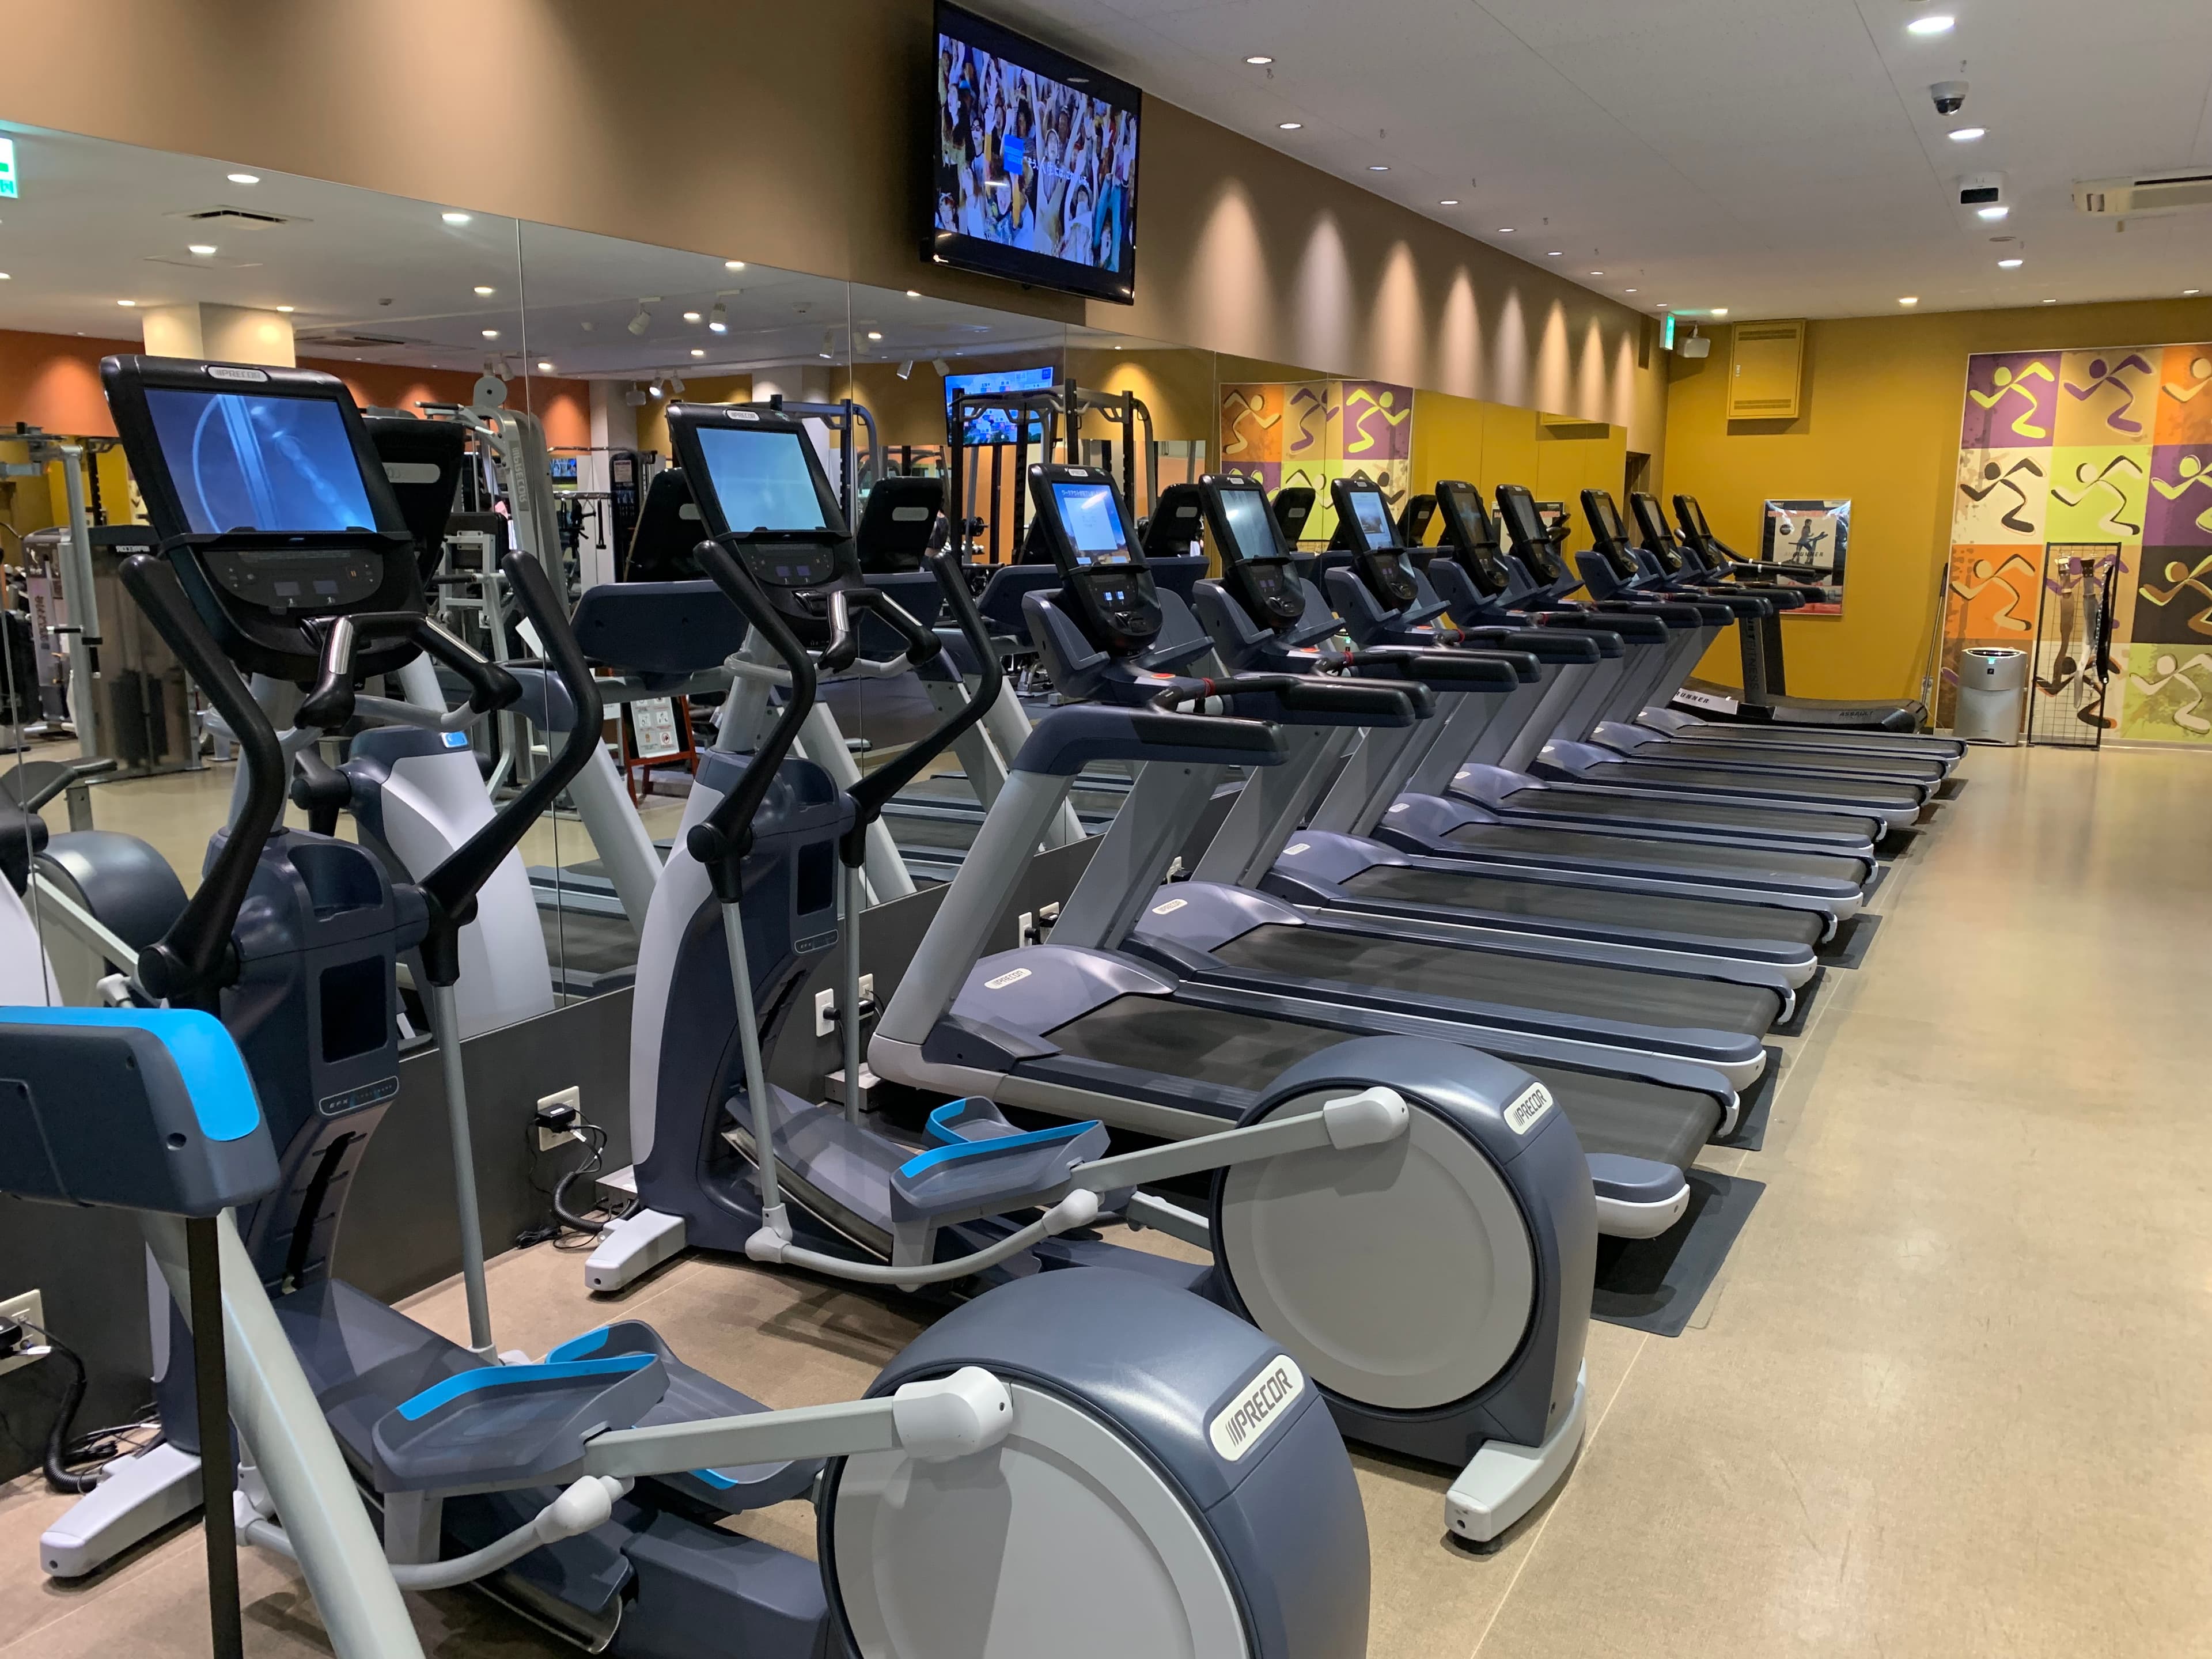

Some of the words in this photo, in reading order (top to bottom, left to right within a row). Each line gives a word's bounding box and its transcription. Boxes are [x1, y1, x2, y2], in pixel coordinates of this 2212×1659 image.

[993, 970, 1024, 985] PRECOR
[1514, 1089, 1547, 1126] PRECOR
[1227, 1368, 1293, 1445] PRECOR
